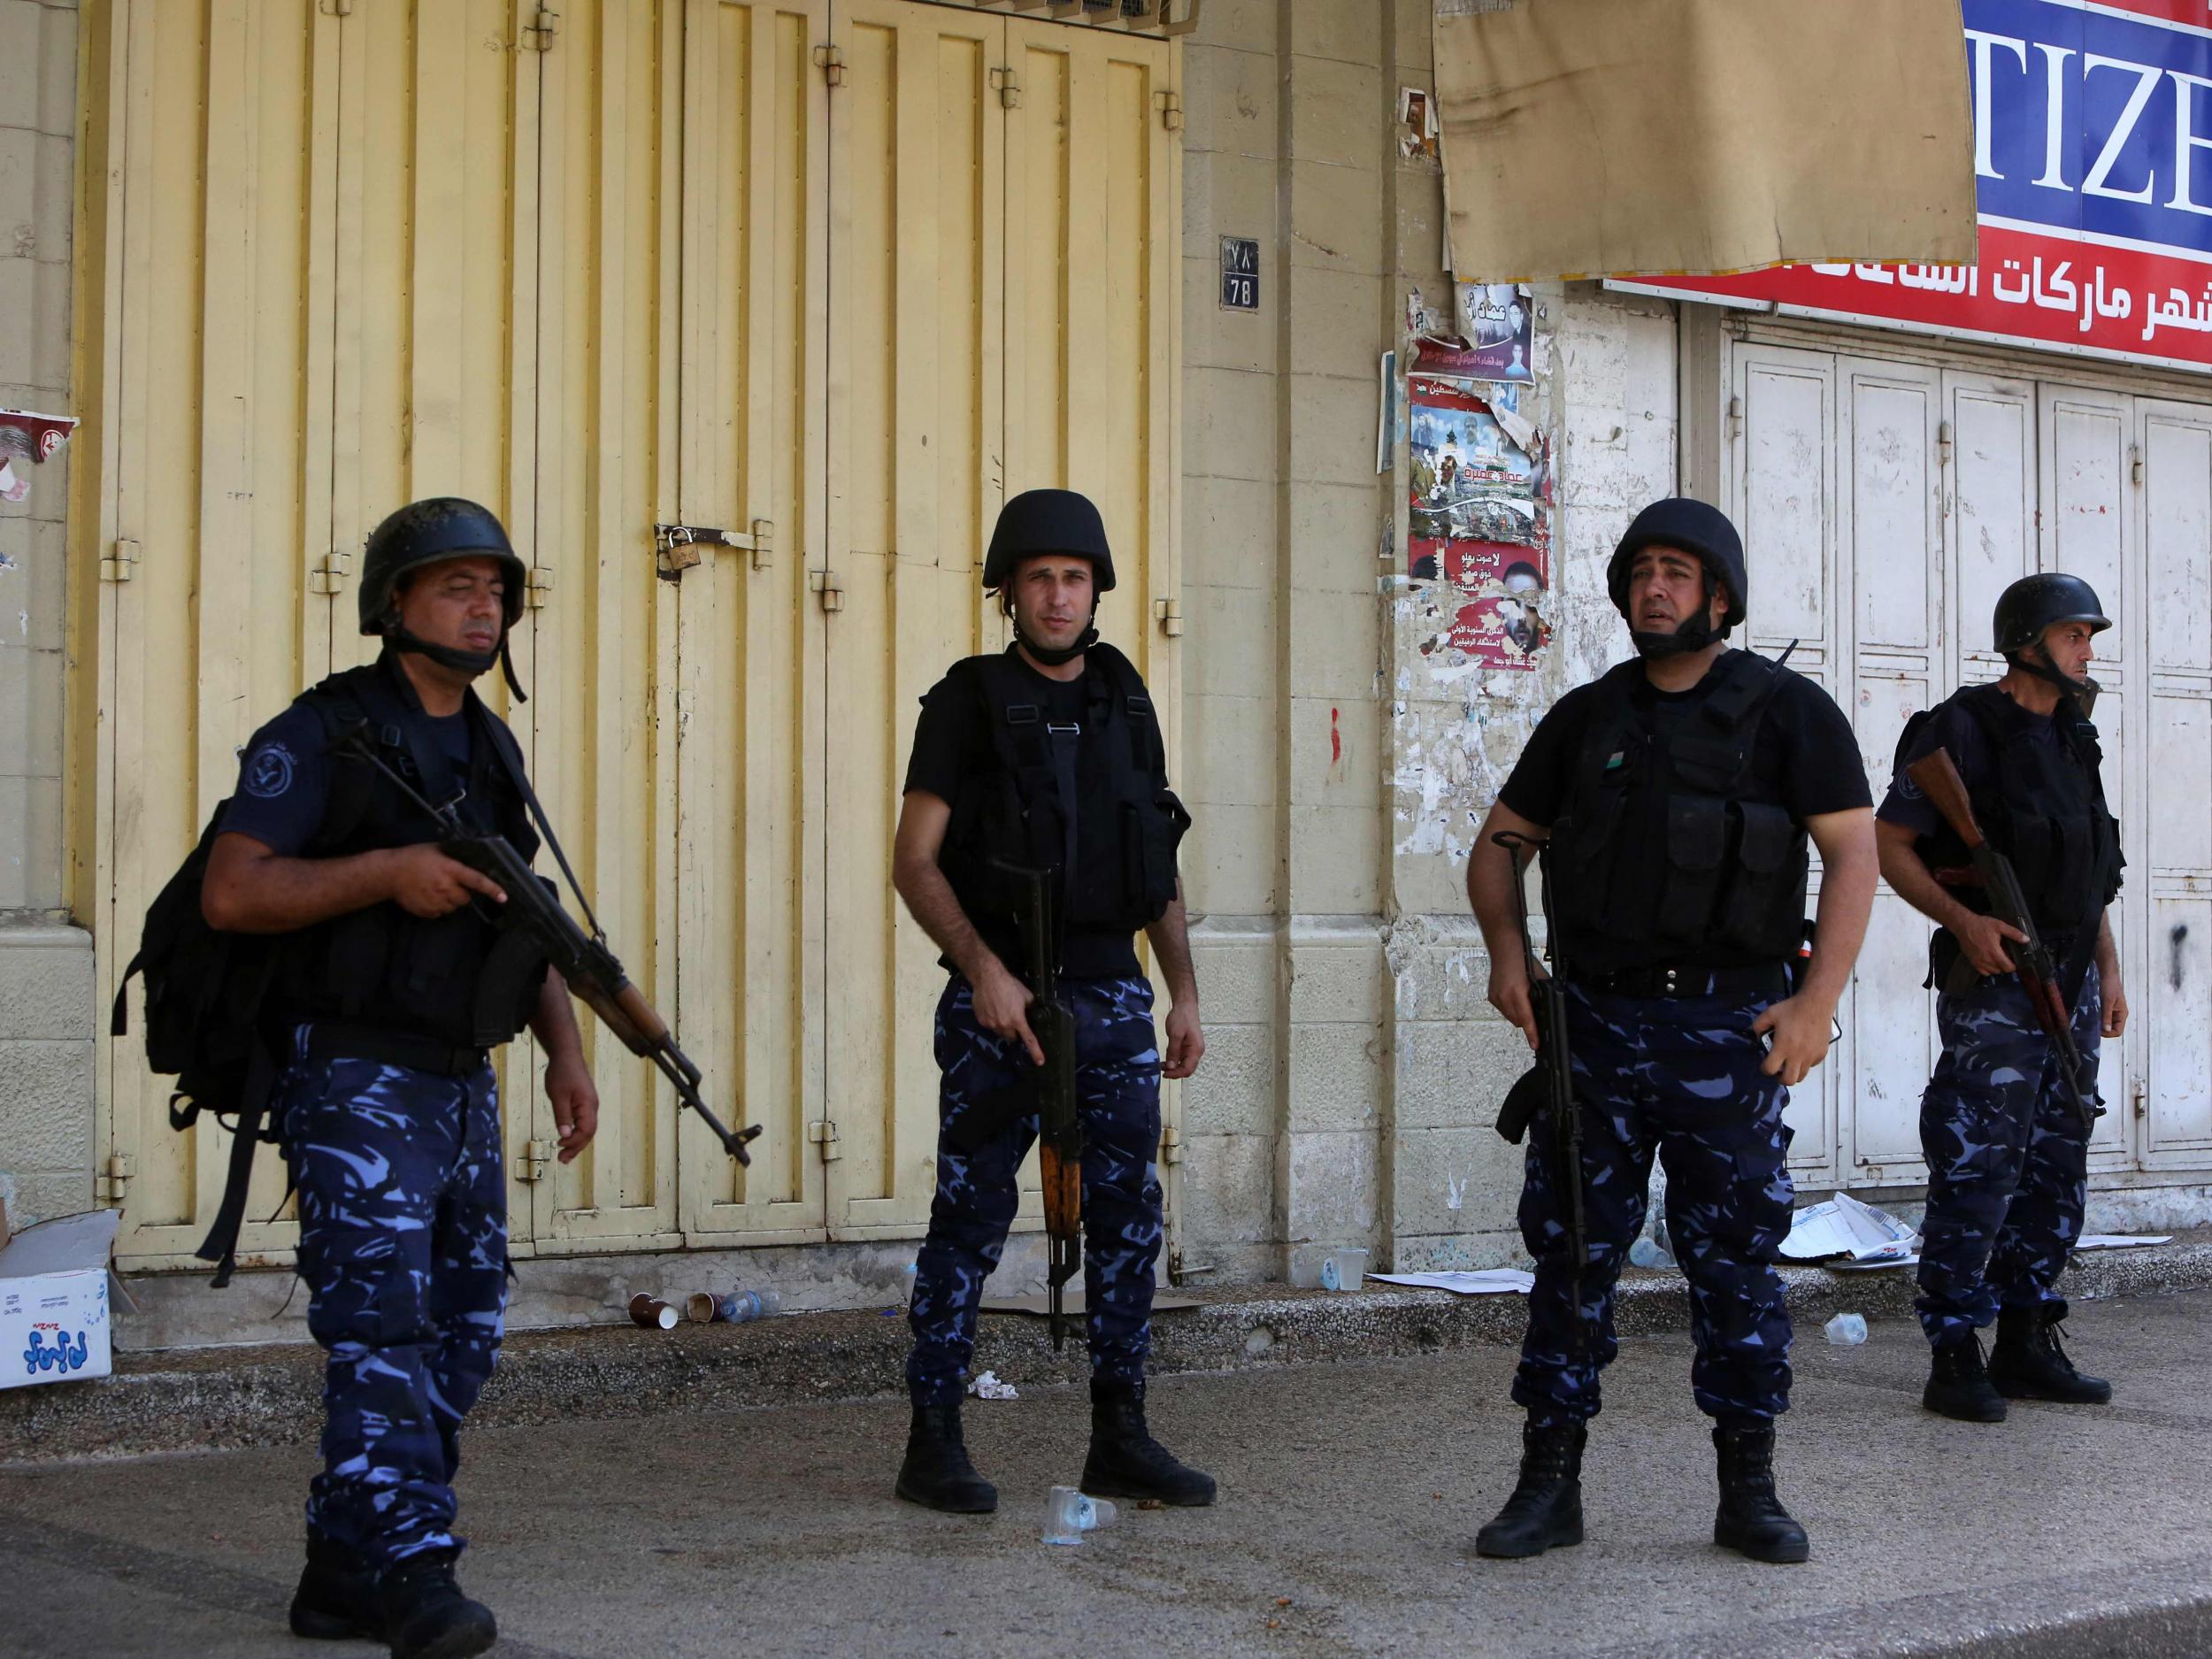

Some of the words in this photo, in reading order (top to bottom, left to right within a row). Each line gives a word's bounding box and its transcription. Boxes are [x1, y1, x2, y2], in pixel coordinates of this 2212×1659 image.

[1231, 279, 1250, 305] 78
[1993, 257, 2131, 333] ماركات
[1477, 554, 1492, 565] صوت
[1493, 552, 1500, 566] لا
[1479, 568, 1492, 580] فوق
[1451, 623, 1466, 635] الأولى
[1467, 625, 1486, 635] السنوية
